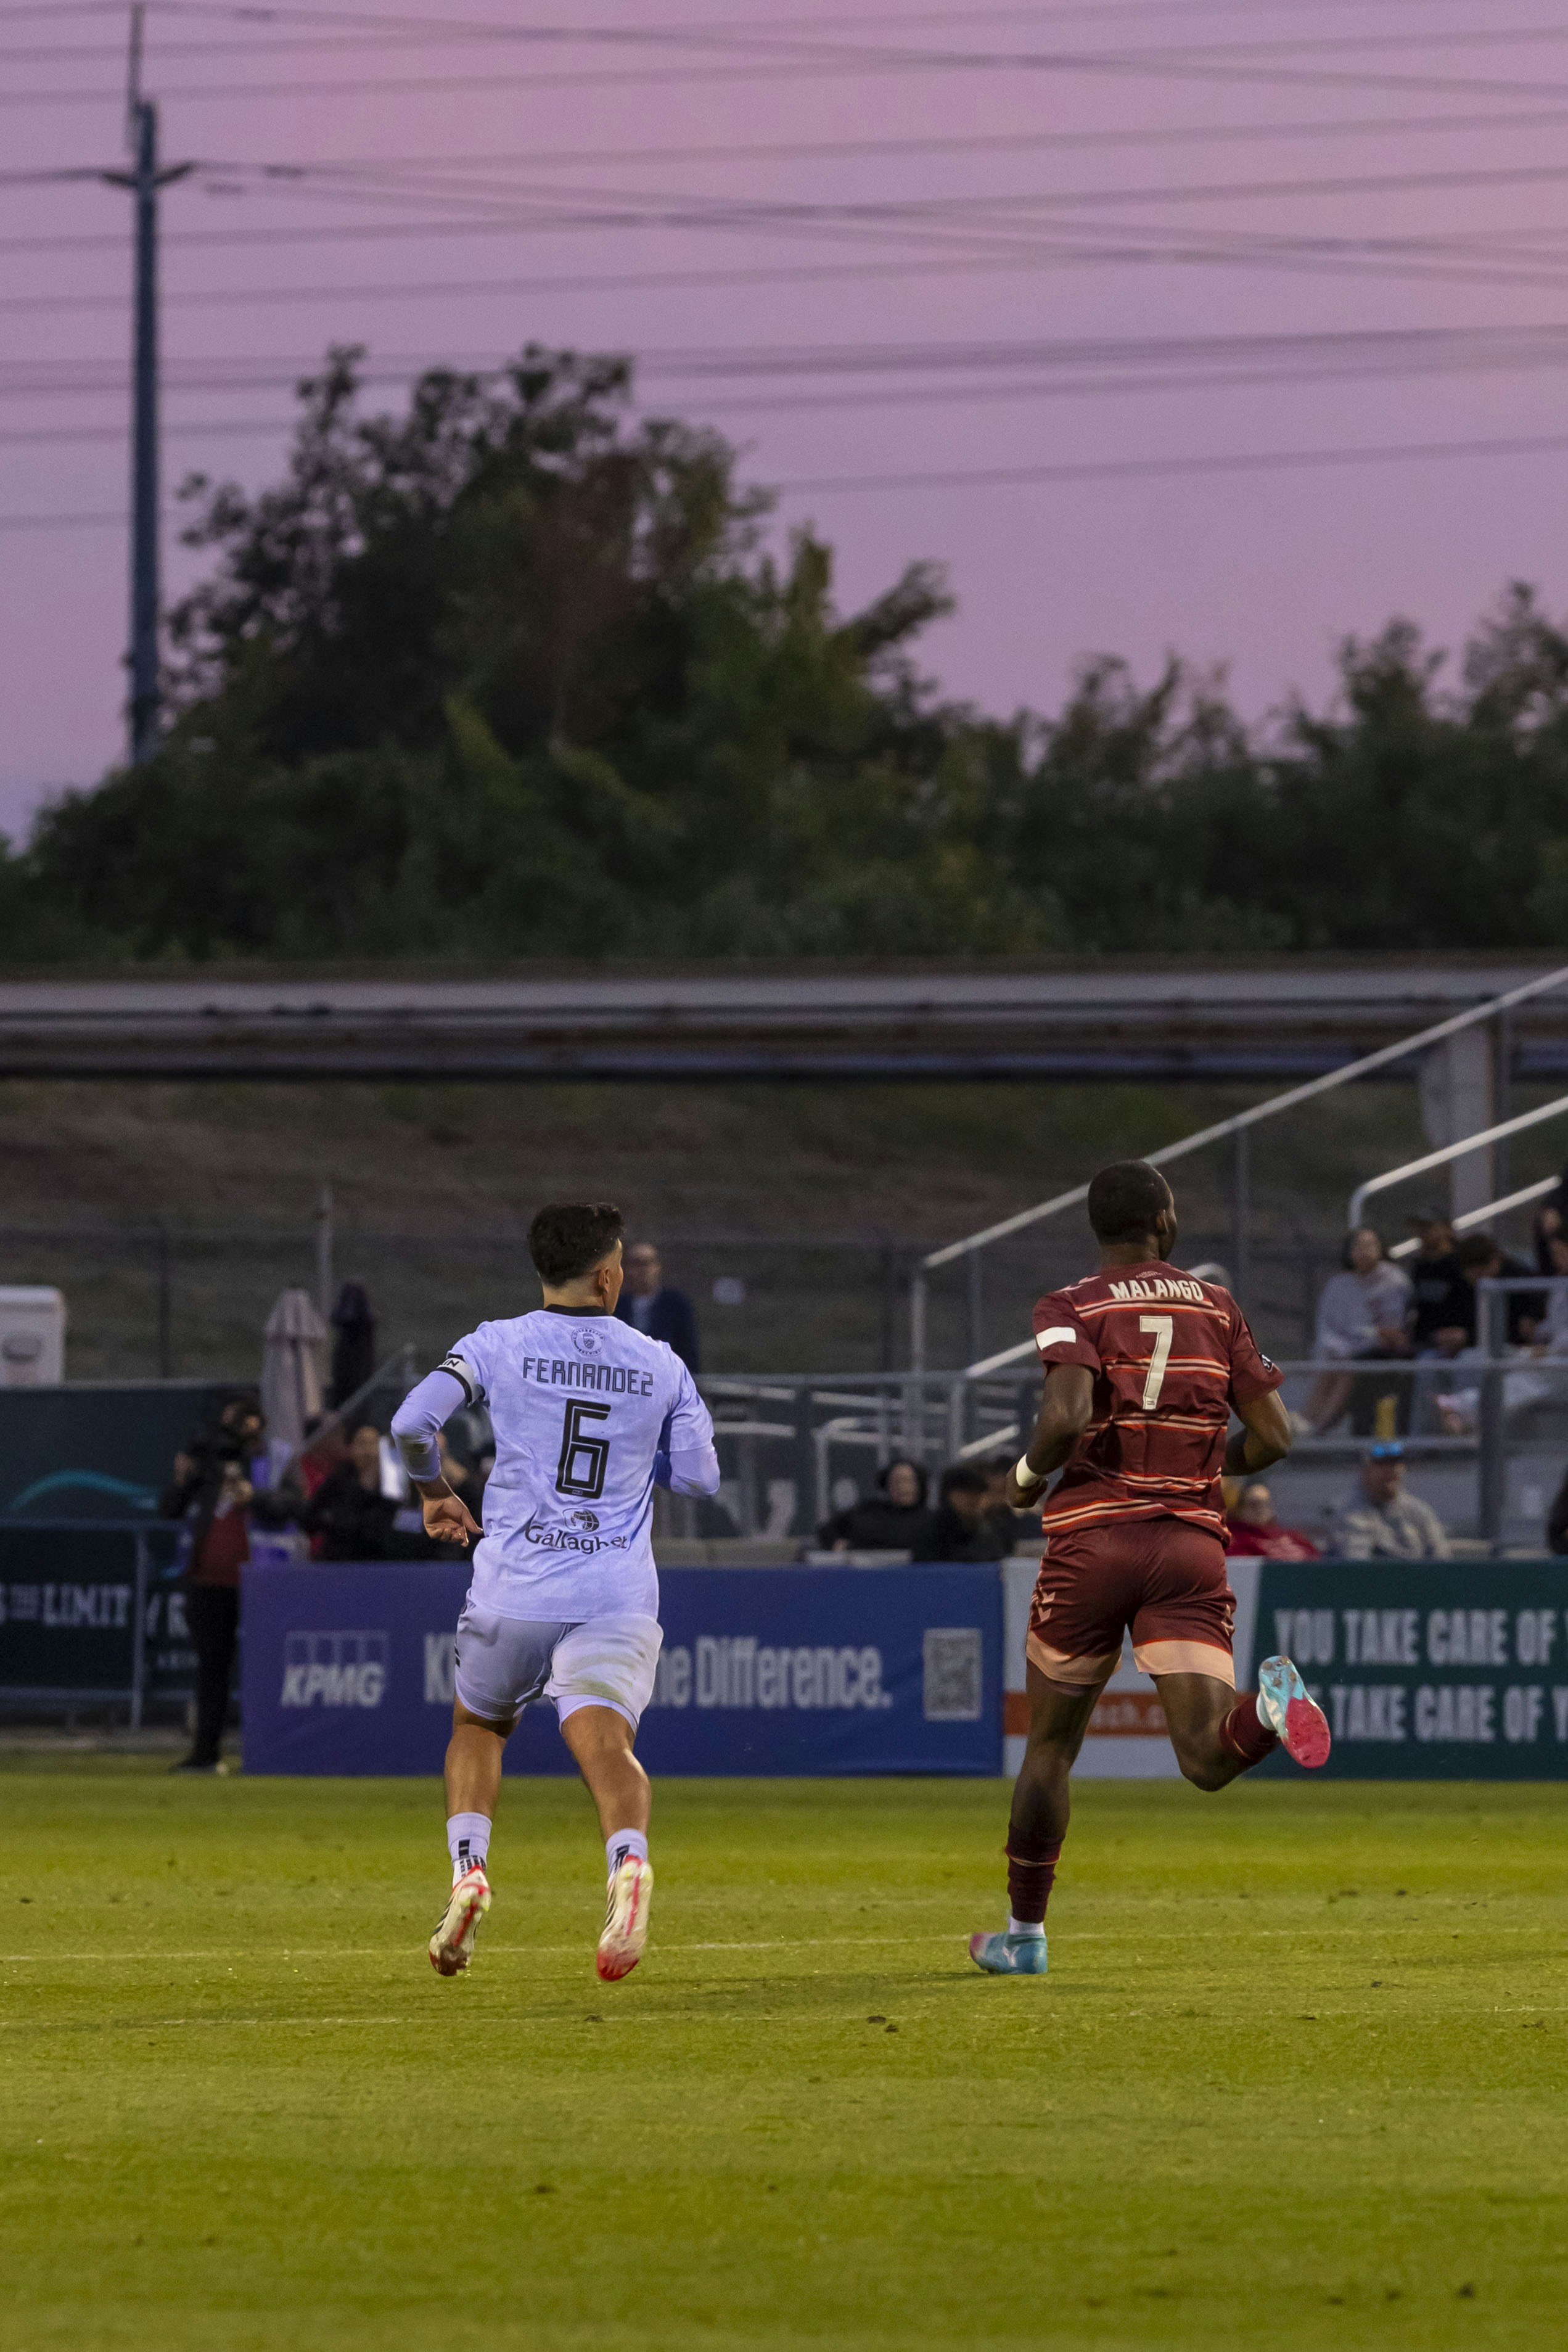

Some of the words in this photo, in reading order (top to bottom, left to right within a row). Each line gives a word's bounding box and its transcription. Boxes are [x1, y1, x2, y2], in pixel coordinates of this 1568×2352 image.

[1108, 1278, 1204, 1301] MALANGO
[523, 1357, 653, 1397] FERNANDEZ
[1139, 1315, 1173, 1410] 7
[555, 1398, 611, 1499] 6
[1275, 1609, 1335, 1664] YOU
[1342, 1609, 1418, 1664] TAKE
[1427, 1609, 1508, 1664] CARE
[1516, 1609, 1556, 1664] OF
[281, 1663, 385, 1707] KPMG
[696, 1636, 893, 1708] Difference.
[1330, 1685, 1406, 1741] TAKE
[1415, 1685, 1495, 1741] CARE
[1503, 1685, 1543, 1741] OF
